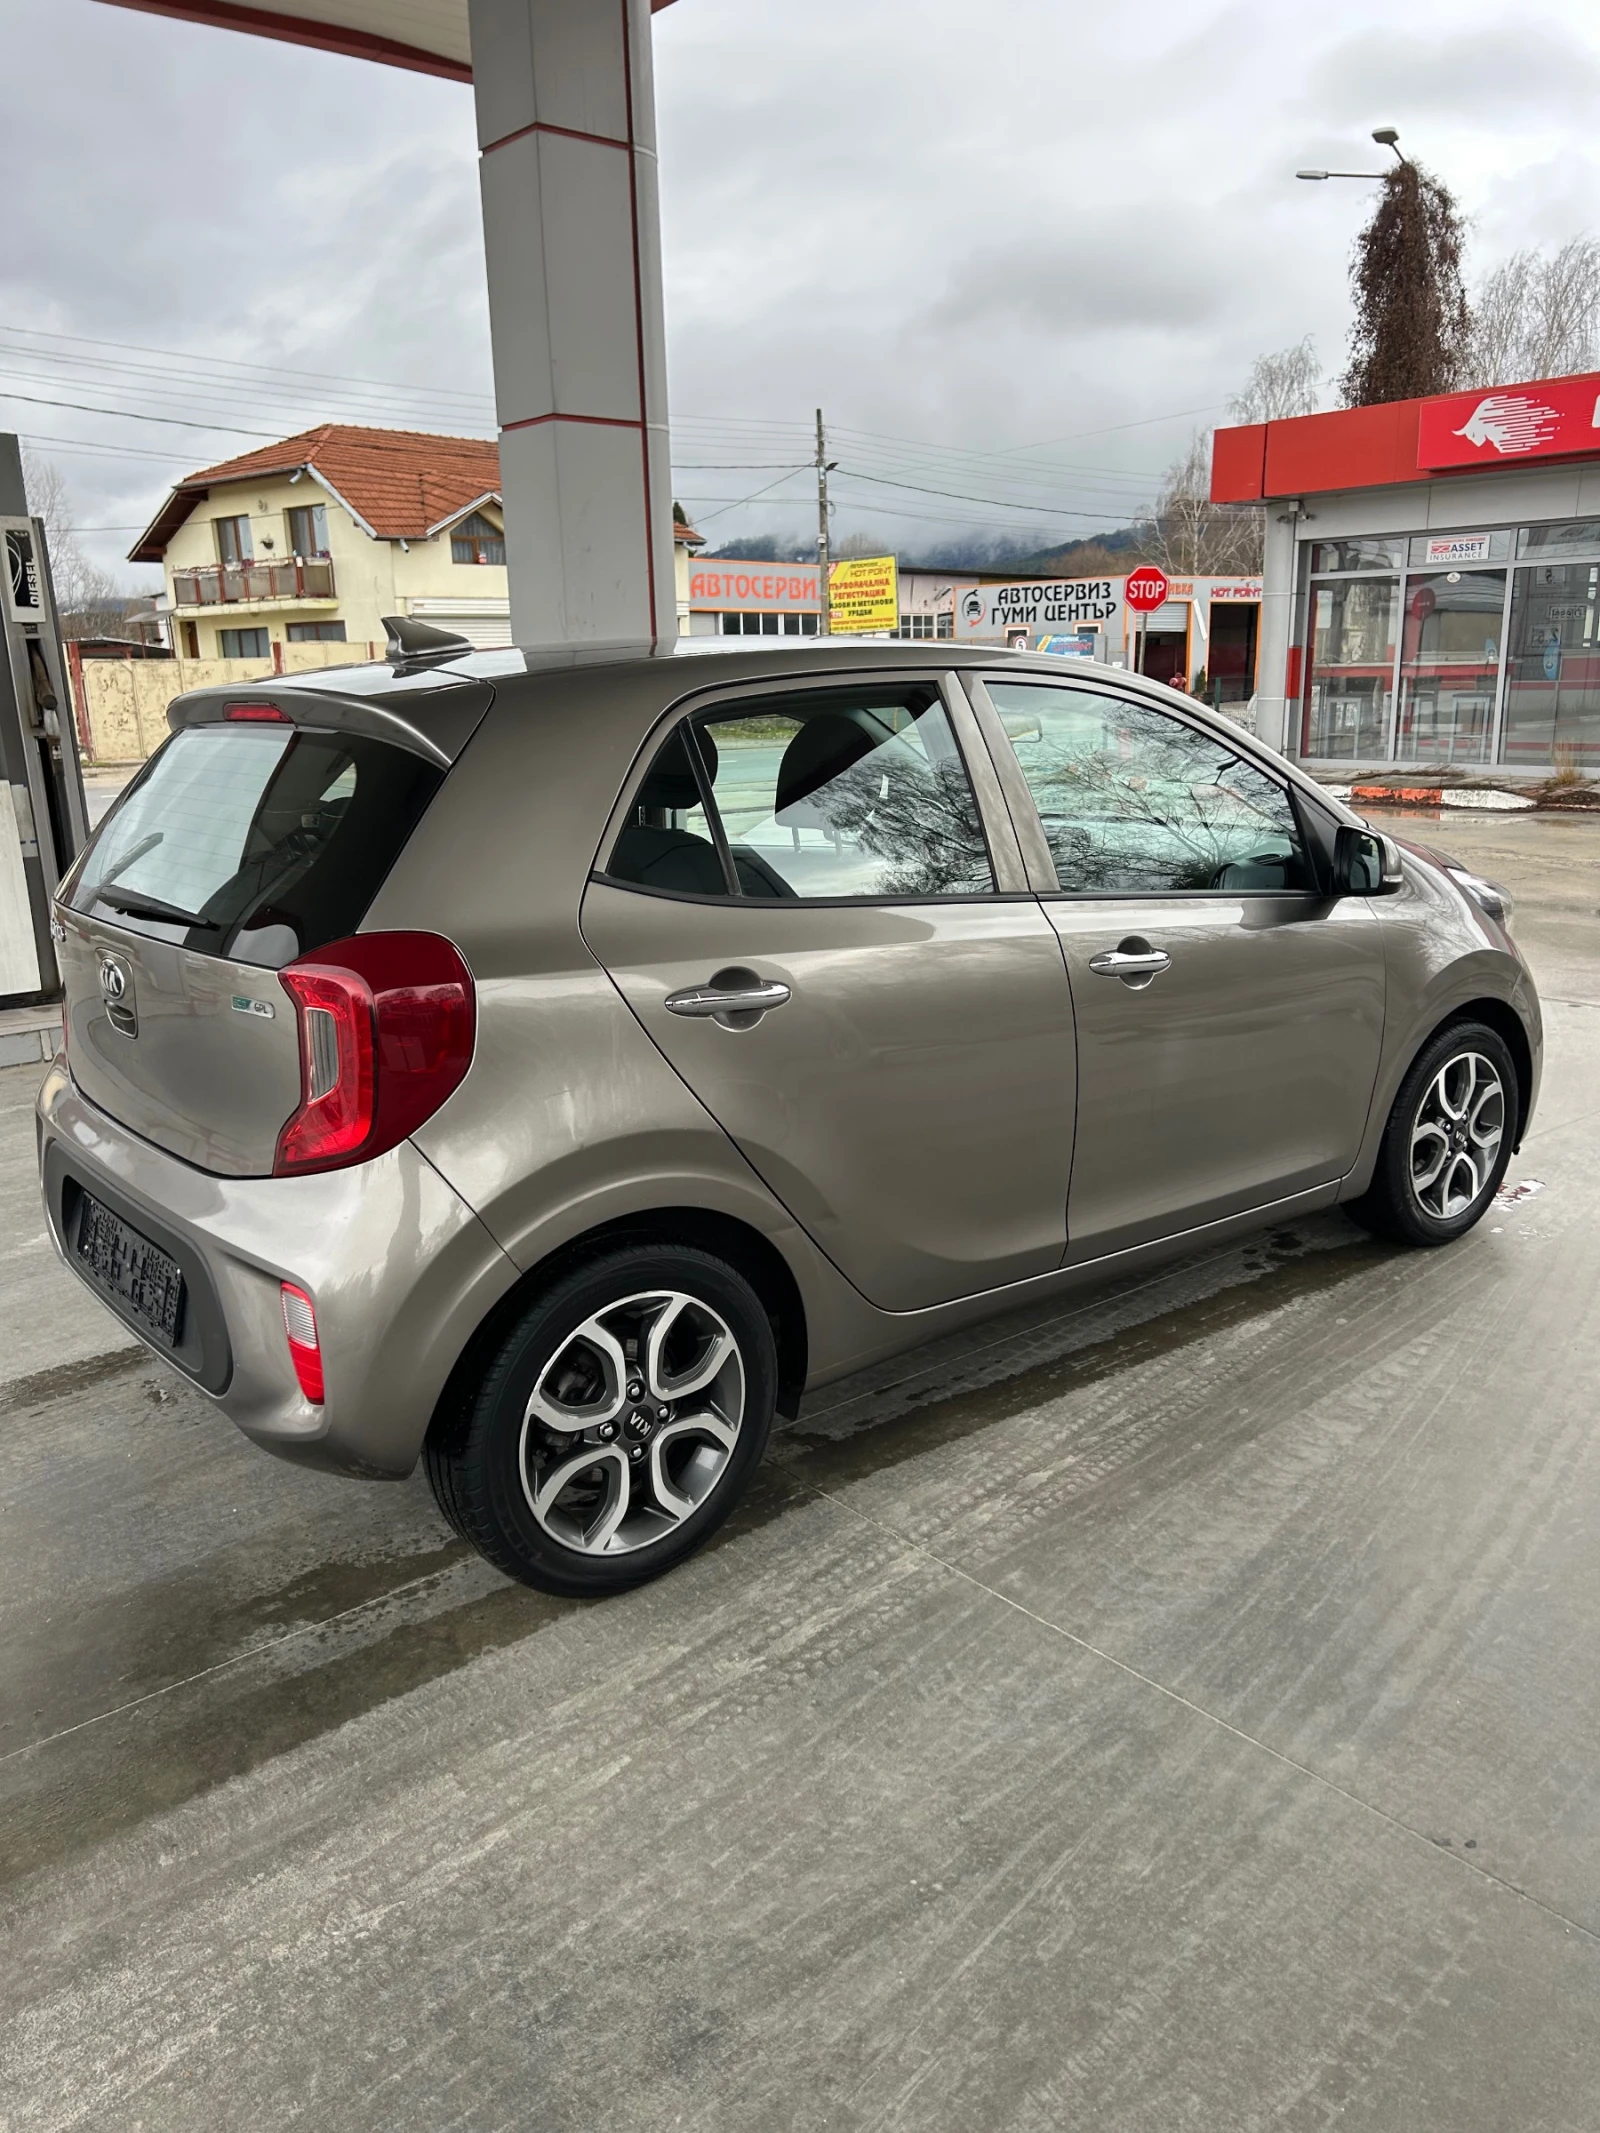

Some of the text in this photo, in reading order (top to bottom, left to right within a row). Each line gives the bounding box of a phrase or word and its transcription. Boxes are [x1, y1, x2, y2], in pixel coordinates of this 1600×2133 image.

[1451, 542, 1485, 553] ASSET
[1430, 551, 1484, 561] INSURANCE
[25, 557, 39, 607] DIESEL
[691, 573, 820, 600] АВТОСЕРВИ
[834, 588, 886, 600] РЕГИСТРАЦИЯ
[998, 582, 1111, 605] АВТОСЕРВИЗ
[1128, 580, 1165, 599] STOP
[1210, 586, 1262, 597] HOT POINT
[858, 598, 893, 607] МЕТАНОВИ
[848, 609, 872, 617] УРЕДБИ
[992, 602, 1116, 625] ГУМИ ЦЕНТЪР
[1018, 641, 1024, 651] 5
[254, 1002, 268, 1014] GPL
[630, 1411, 651, 1436] KIA
